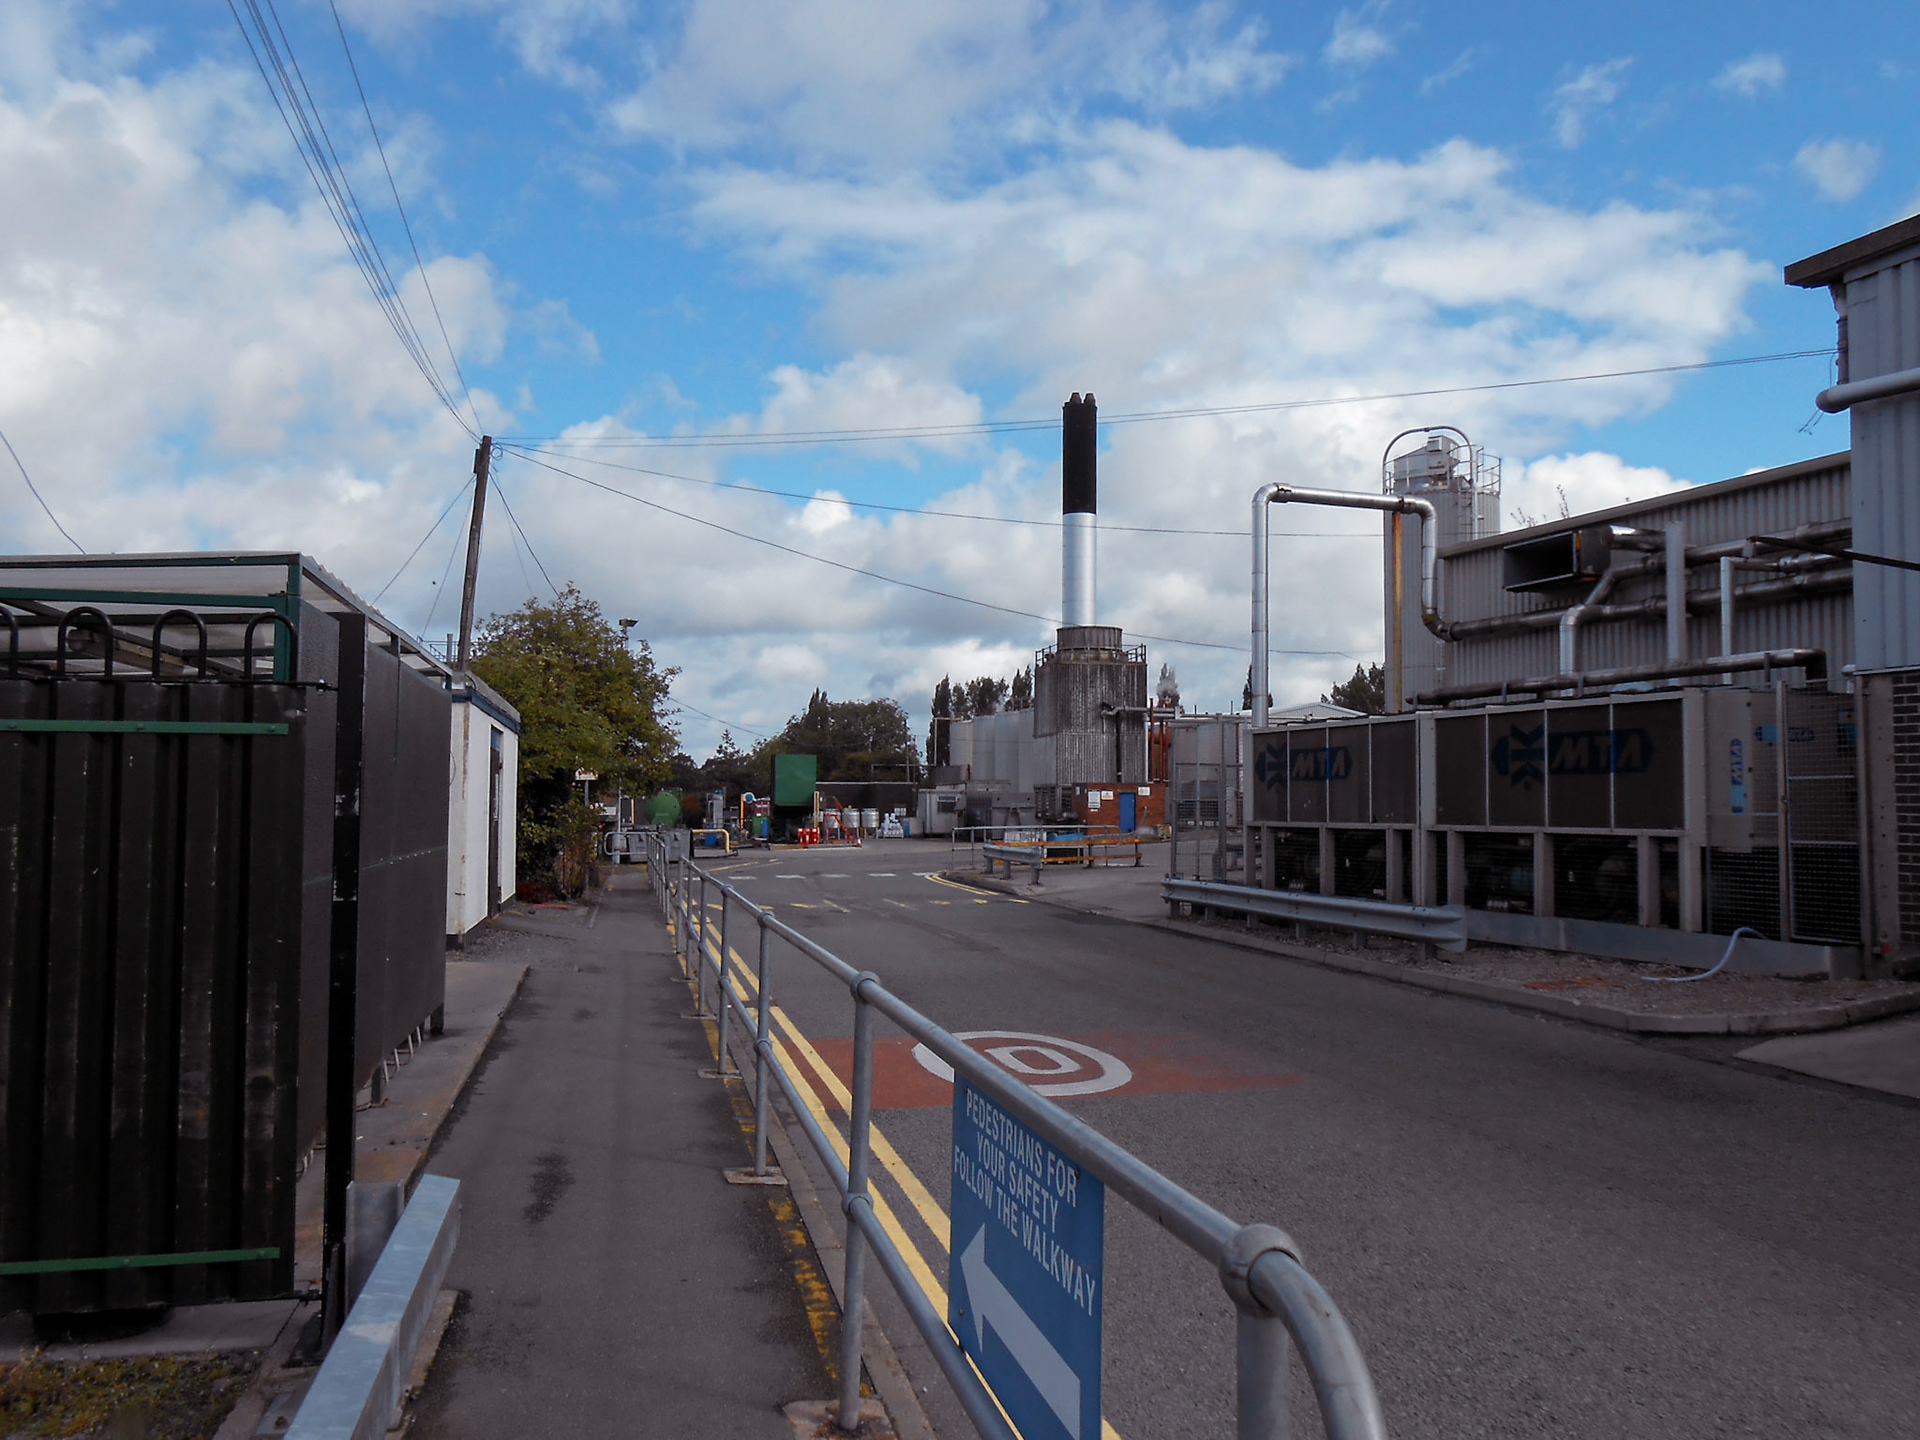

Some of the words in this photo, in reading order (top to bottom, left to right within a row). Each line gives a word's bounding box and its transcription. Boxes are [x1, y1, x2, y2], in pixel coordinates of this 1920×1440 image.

[1290, 750, 1346, 778] MTA
[1550, 734, 1643, 770] MTA
[966, 1088, 1043, 1178] PEDESTRIANS
[1048, 1151, 1077, 1208] FOR
[977, 1132, 1005, 1185] YOUR
[1009, 1161, 1059, 1233] SAFETY
[954, 1145, 994, 1210] FOLLOW
[997, 1186, 1018, 1238] THE
[1022, 1211, 1096, 1317] WALKWAY
